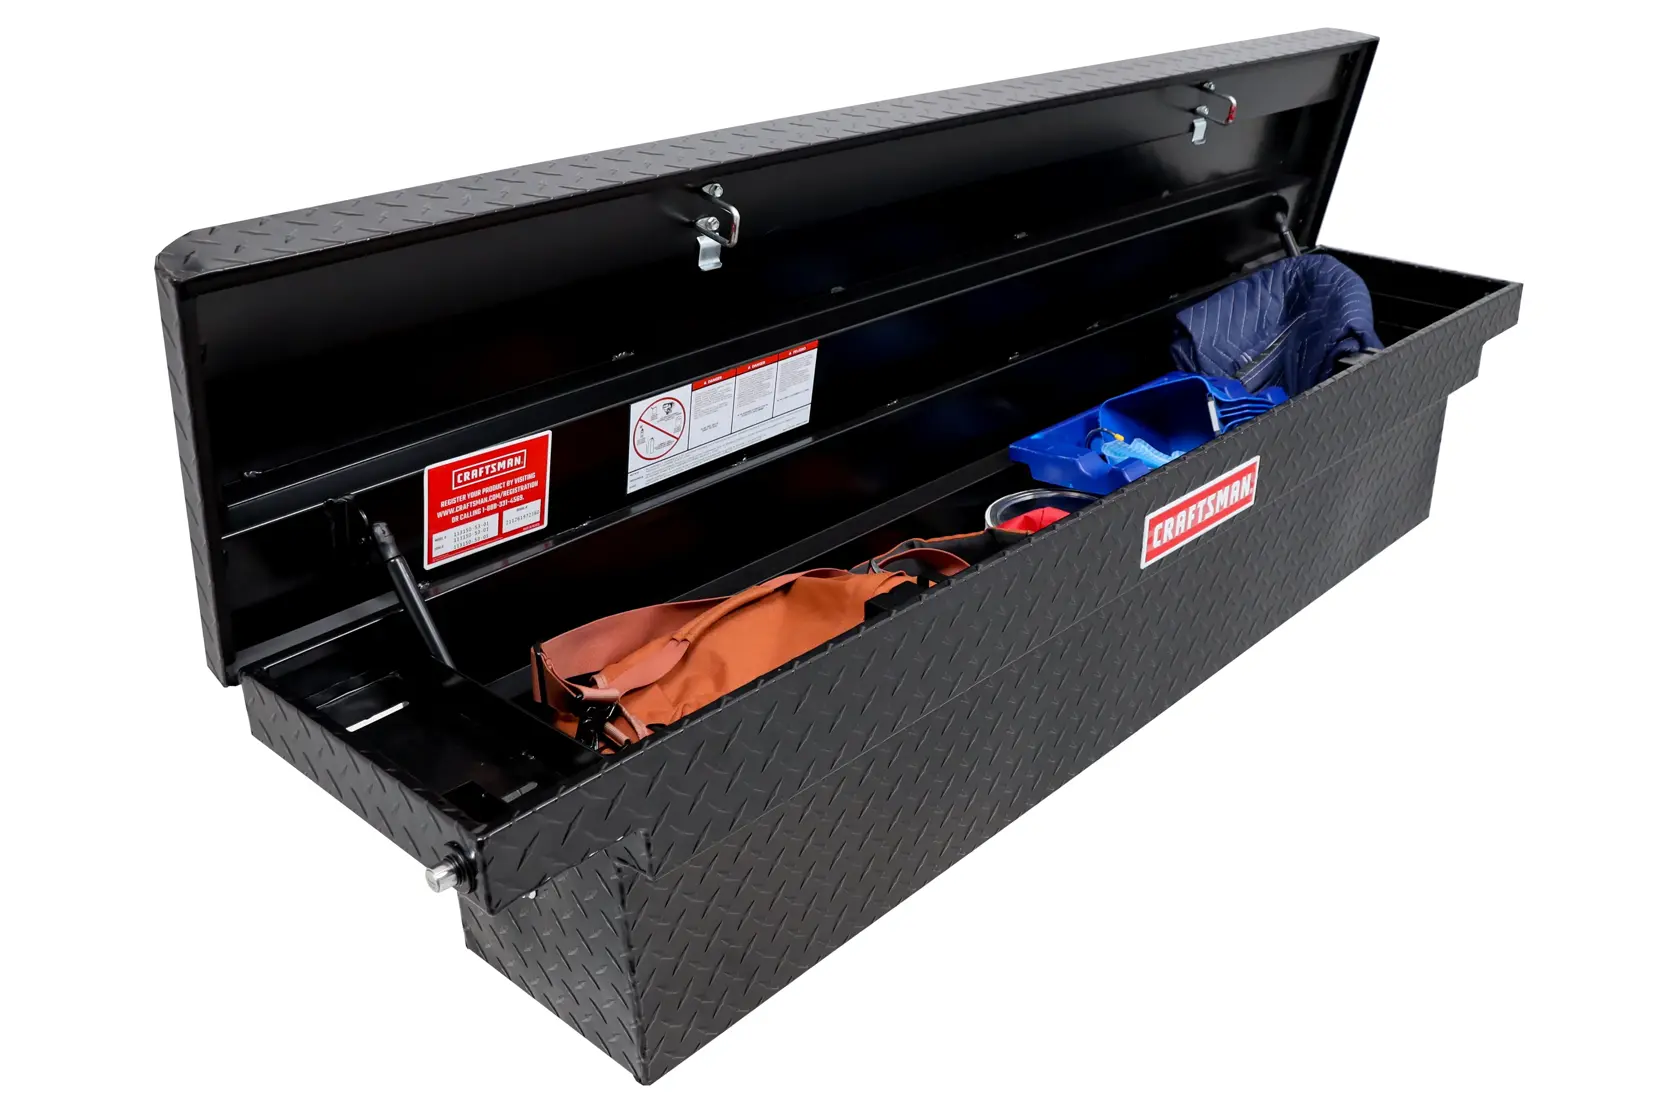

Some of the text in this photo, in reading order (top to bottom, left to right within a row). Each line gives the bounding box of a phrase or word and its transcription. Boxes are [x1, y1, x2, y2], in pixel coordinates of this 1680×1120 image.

[457, 455, 521, 484] CRAFTSMAN
[437, 480, 539, 518] WWW.CRAFTSMAN.COM/REGISTRATION
[440, 472, 536, 508] REGISTER YOUR PRODUCT BY VISITING
[452, 515, 459, 523] OR
[460, 507, 481, 521] CALLING
[1153, 472, 1253, 549] CRAFTSMAN
